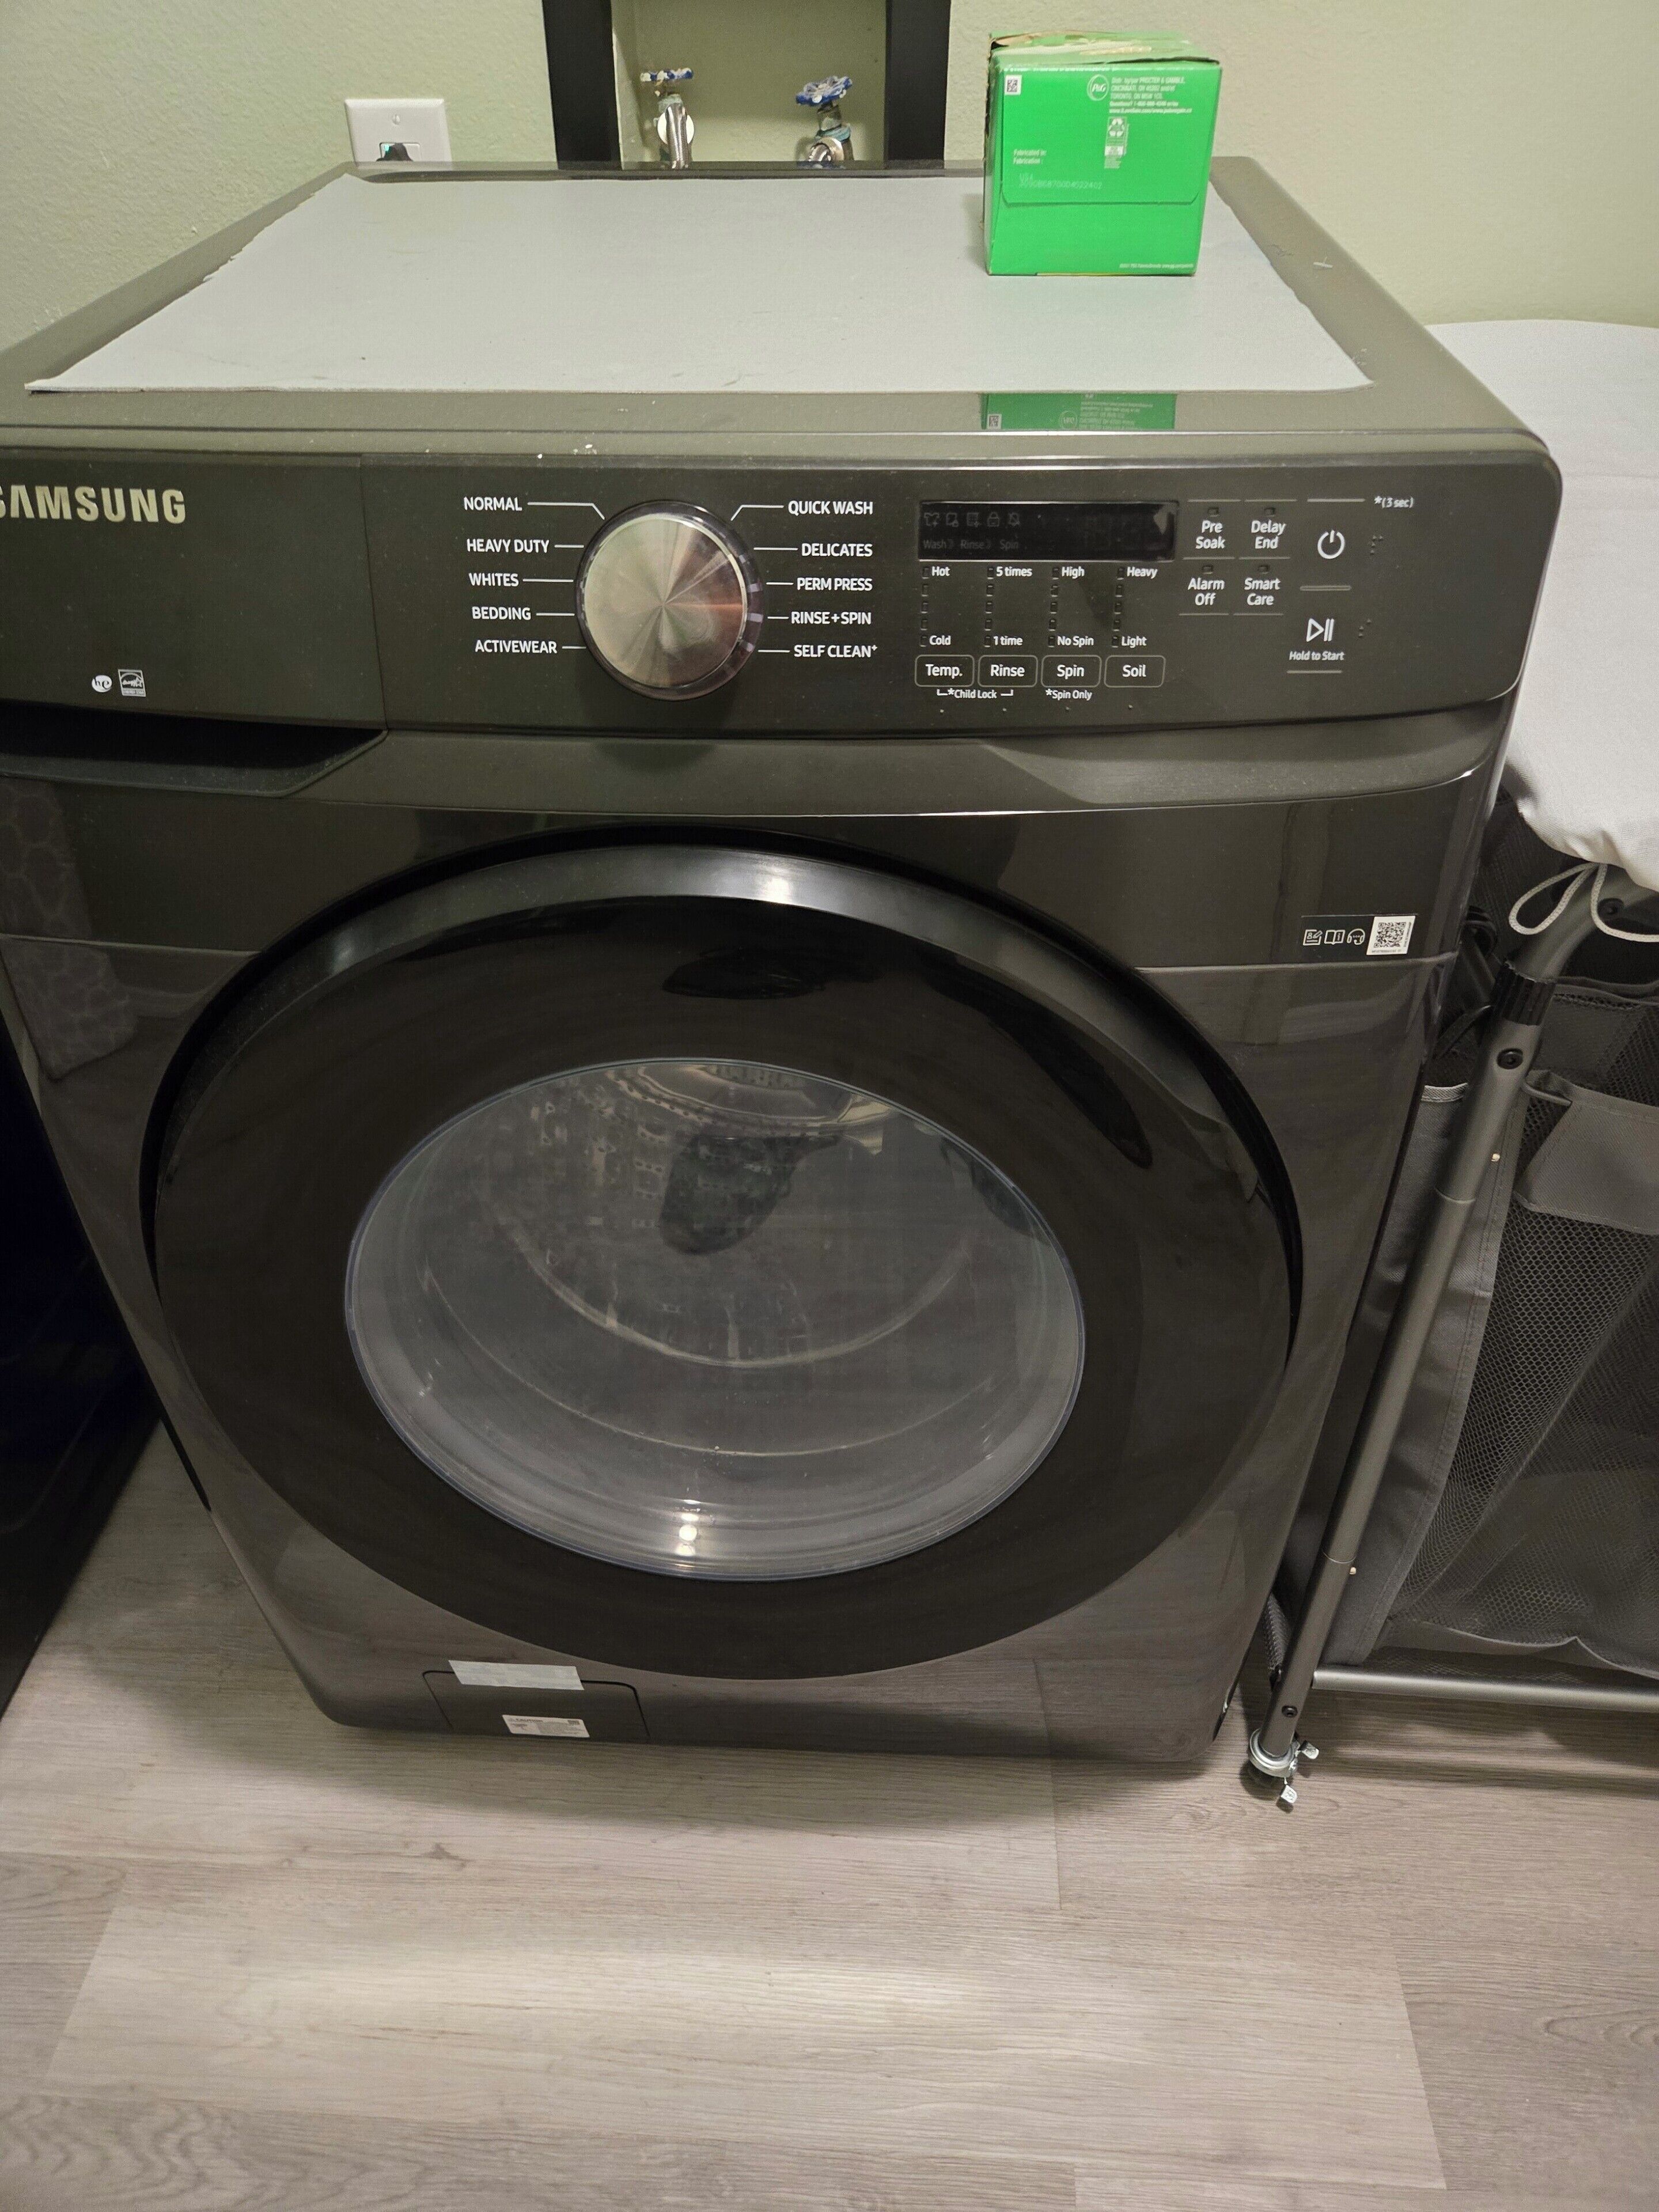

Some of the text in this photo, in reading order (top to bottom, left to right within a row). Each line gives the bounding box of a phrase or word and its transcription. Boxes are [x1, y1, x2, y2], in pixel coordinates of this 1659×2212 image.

[464, 497, 522, 510] NORMAL
[1394, 497, 1413, 507] sec)
[788, 501, 873, 516] QUICK WASH
[1202, 520, 1222, 533] Pre
[1251, 520, 1286, 535] Delay
[467, 539, 549, 553] HEAVY DUTY
[923, 539, 1018, 551] Wash Rinse Spin
[1196, 536, 1225, 548] Soak
[1255, 536, 1278, 548] End
[802, 543, 872, 556] DELICATES
[932, 566, 950, 576] Hot
[997, 566, 1032, 577] 5 times
[1062, 566, 1084, 578] High
[1127, 567, 1157, 578] Heavy
[469, 573, 518, 586] WHITES
[797, 578, 872, 590] PERM PRESS
[1188, 578, 1225, 590] Alarm
[1244, 578, 1281, 590] Smart
[1195, 593, 1215, 605] Off
[1247, 593, 1274, 605] Care
[472, 607, 531, 620] BEDDING
[930, 635, 950, 645] Cold
[994, 636, 1022, 645] 1 time
[1058, 636, 1093, 647] No Spin
[1122, 636, 1147, 648] Light
[475, 640, 557, 653] ACTIVEWEAR
[794, 645, 825, 657] SELF
[1289, 651, 1344, 660] Hold to Start
[926, 664, 963, 679] Temp.
[991, 664, 1025, 676] Rinse
[1057, 665, 1084, 679] Spin
[1123, 665, 1146, 677] Soil
[978, 690, 997, 698] Lock
[1073, 690, 1092, 701] Only
